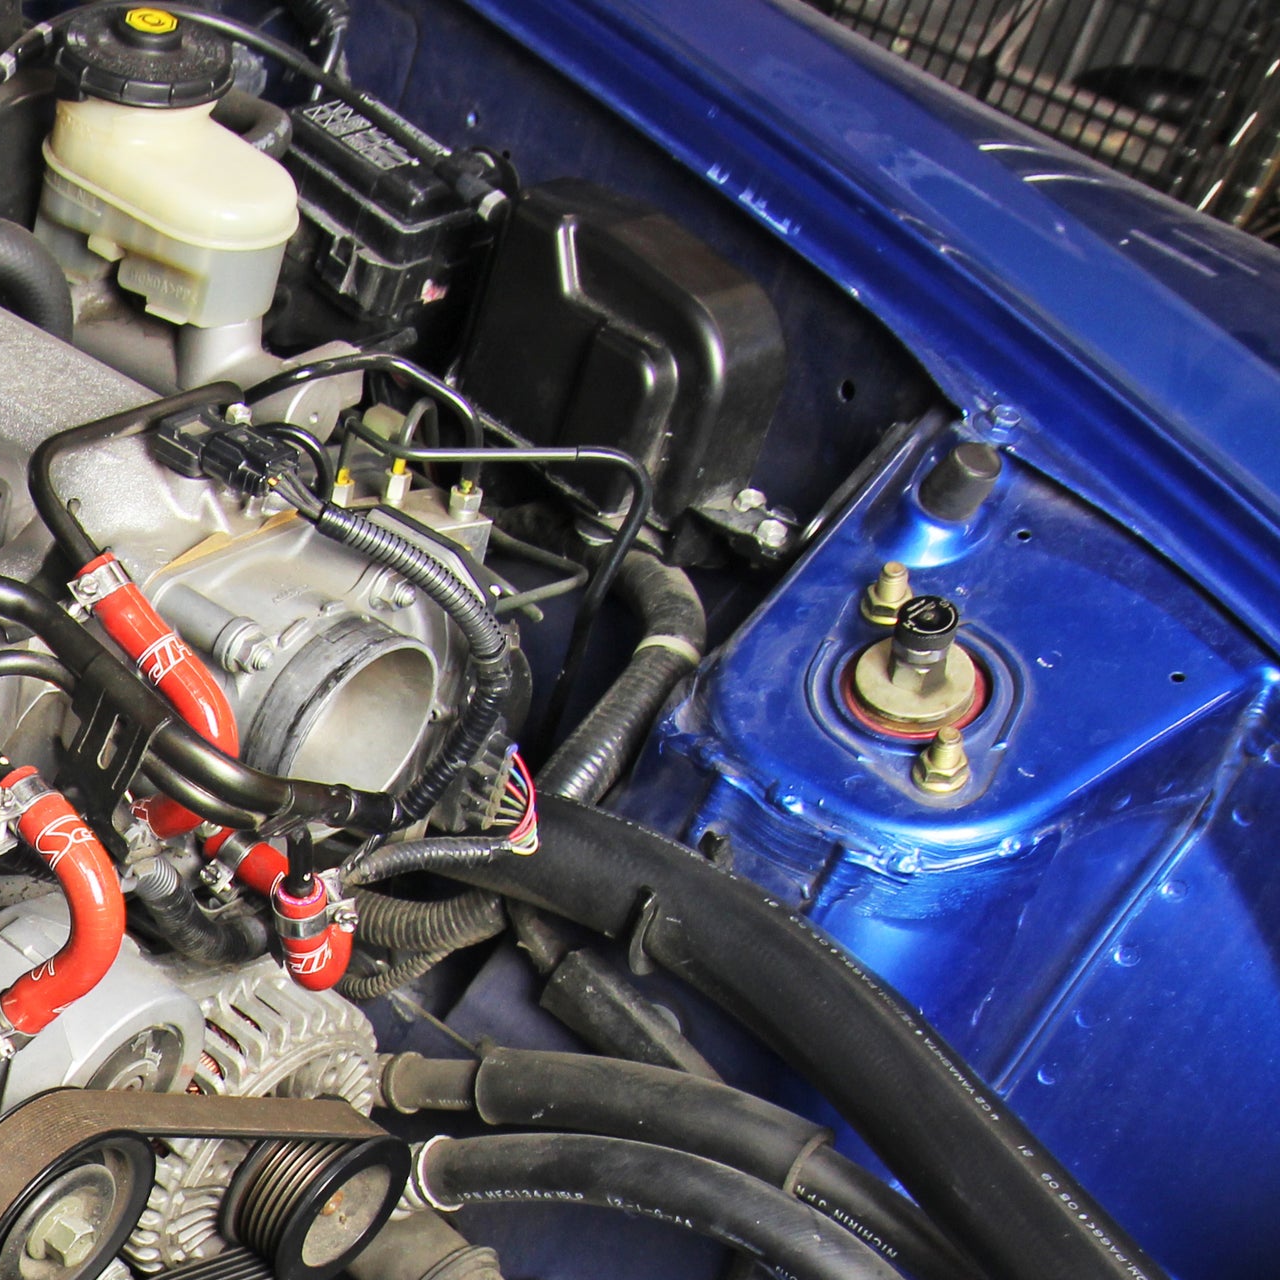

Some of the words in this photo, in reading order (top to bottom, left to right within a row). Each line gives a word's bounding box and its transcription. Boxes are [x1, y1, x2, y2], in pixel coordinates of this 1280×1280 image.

[921, 1035, 977, 1096] YAMASHITA
[793, 1182, 828, 1210] JPN
[830, 1207, 899, 1259] NICHIRIN
